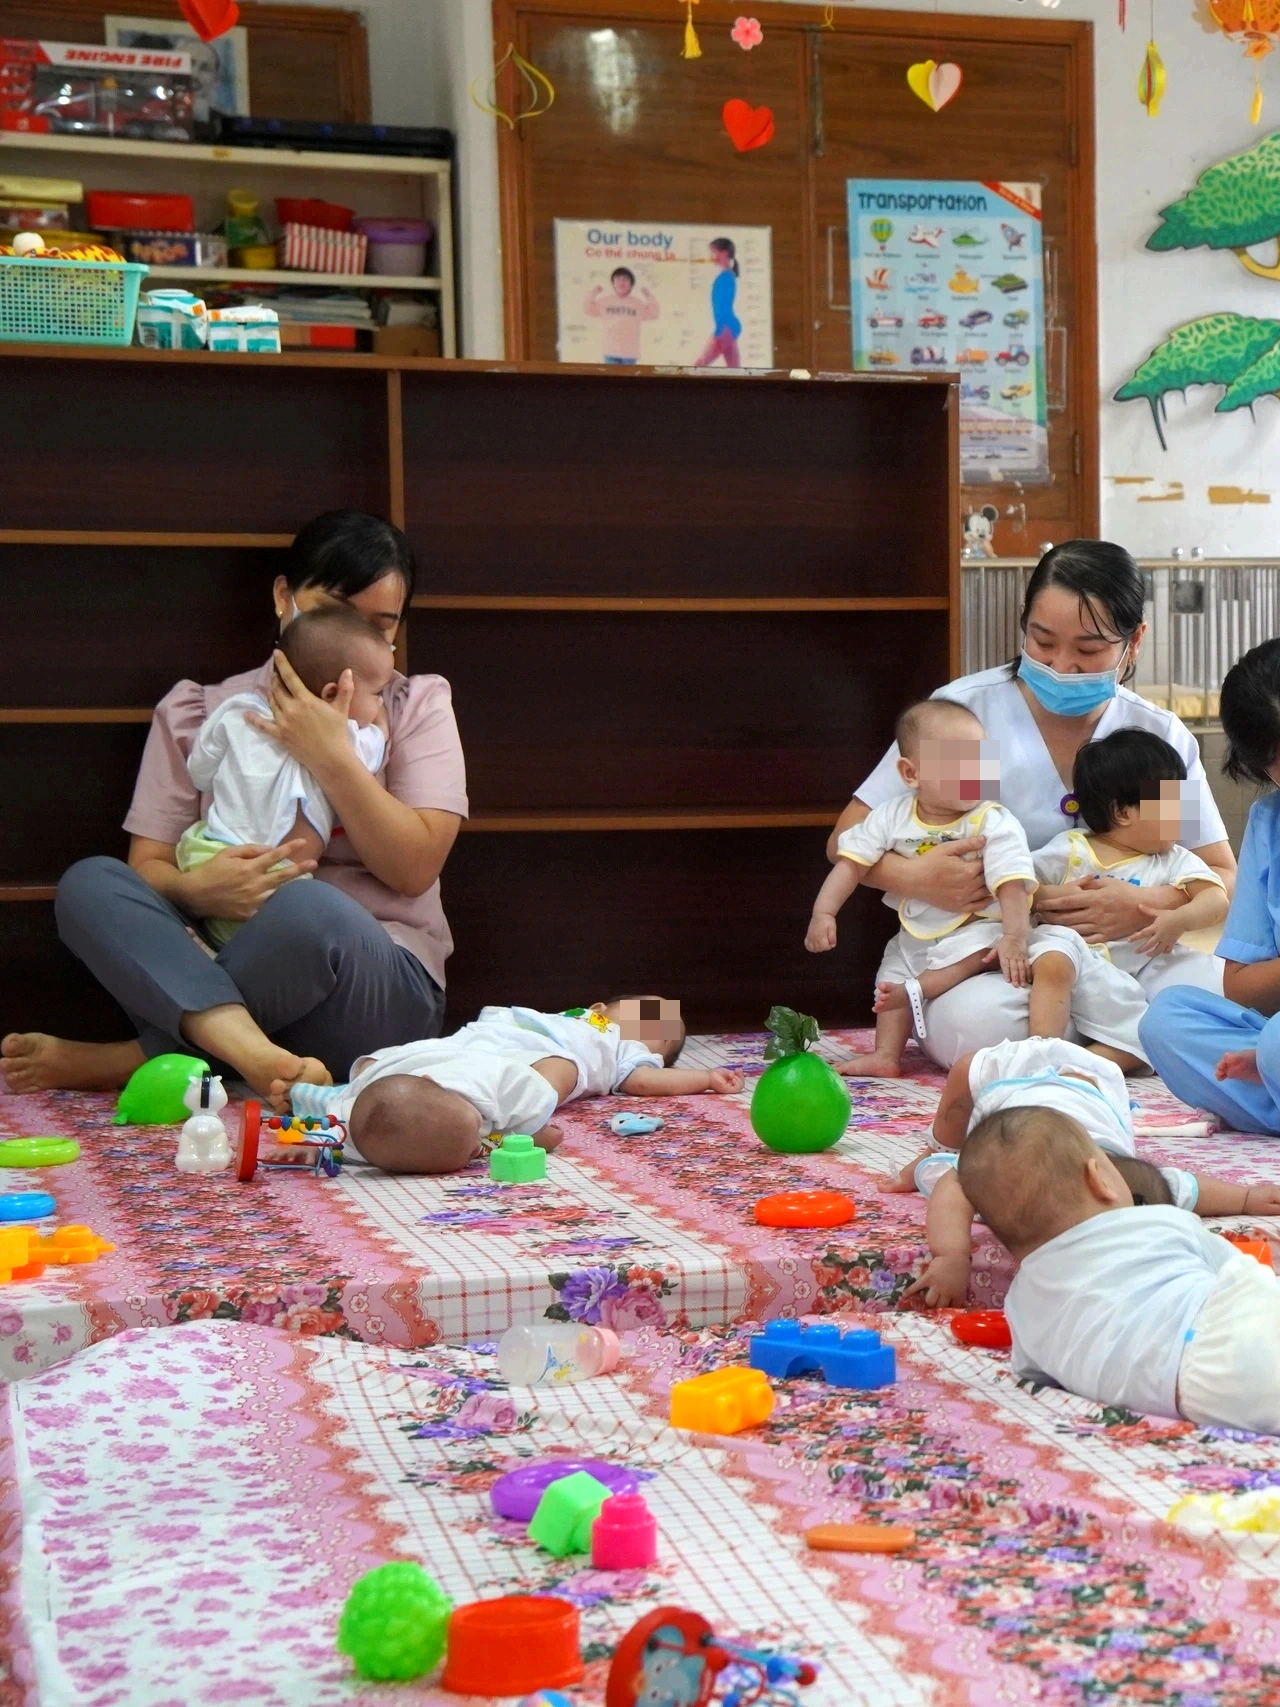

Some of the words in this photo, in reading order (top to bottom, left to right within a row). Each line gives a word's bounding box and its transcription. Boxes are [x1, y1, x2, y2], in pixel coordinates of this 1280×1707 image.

[65, 48, 137, 64] ENGINE
[141, 55, 183, 69] FIRE
[858, 191, 988, 212] Transportation
[587, 228, 622, 246] Our
[627, 231, 674, 250] body
